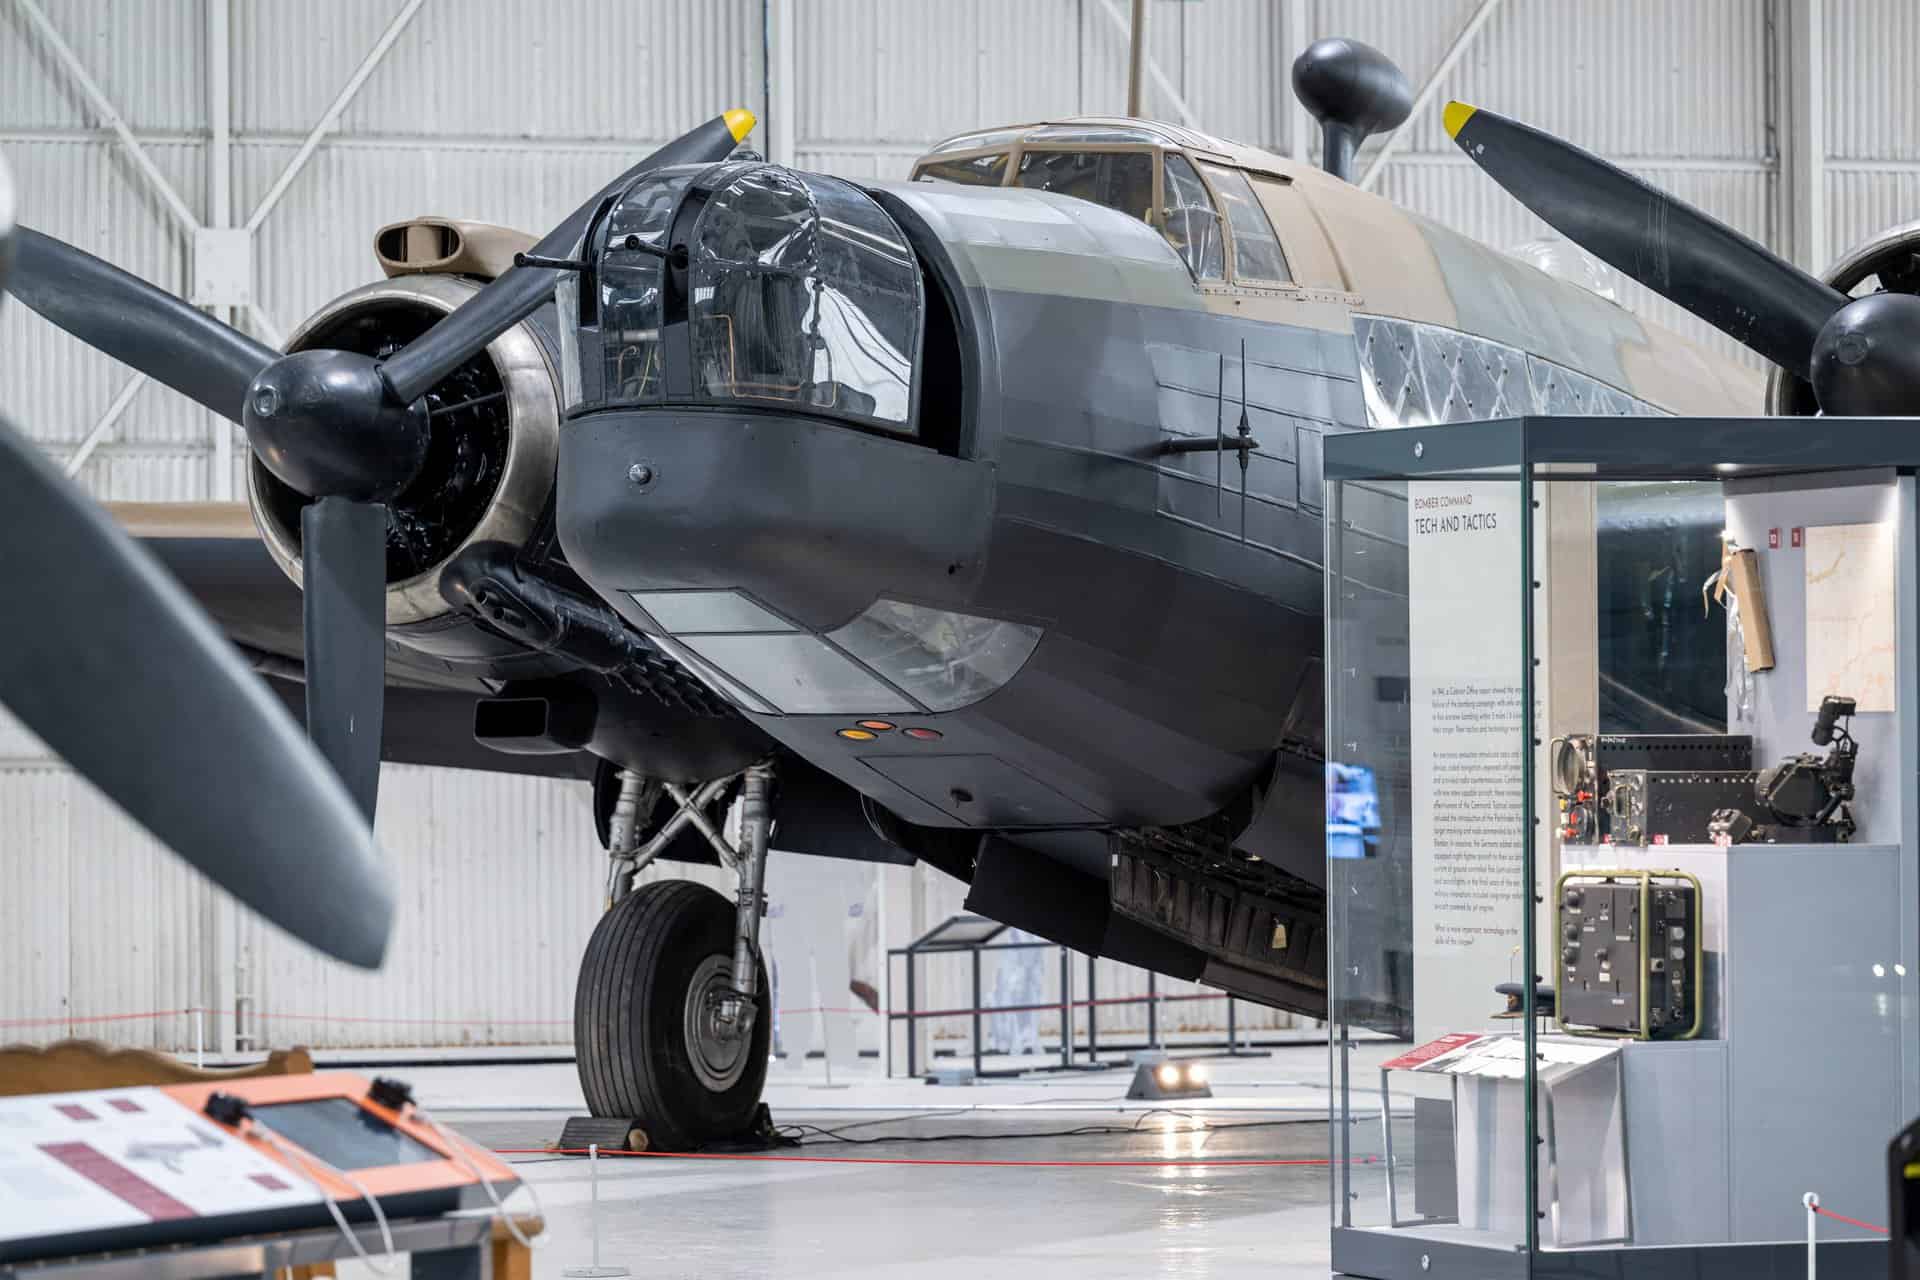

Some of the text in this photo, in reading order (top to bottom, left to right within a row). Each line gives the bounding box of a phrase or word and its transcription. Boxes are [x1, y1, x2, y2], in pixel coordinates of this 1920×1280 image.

[1414, 494, 1472, 509] BOMBER COMMAND
[1415, 513, 1496, 534] TECH AND TACTICS
